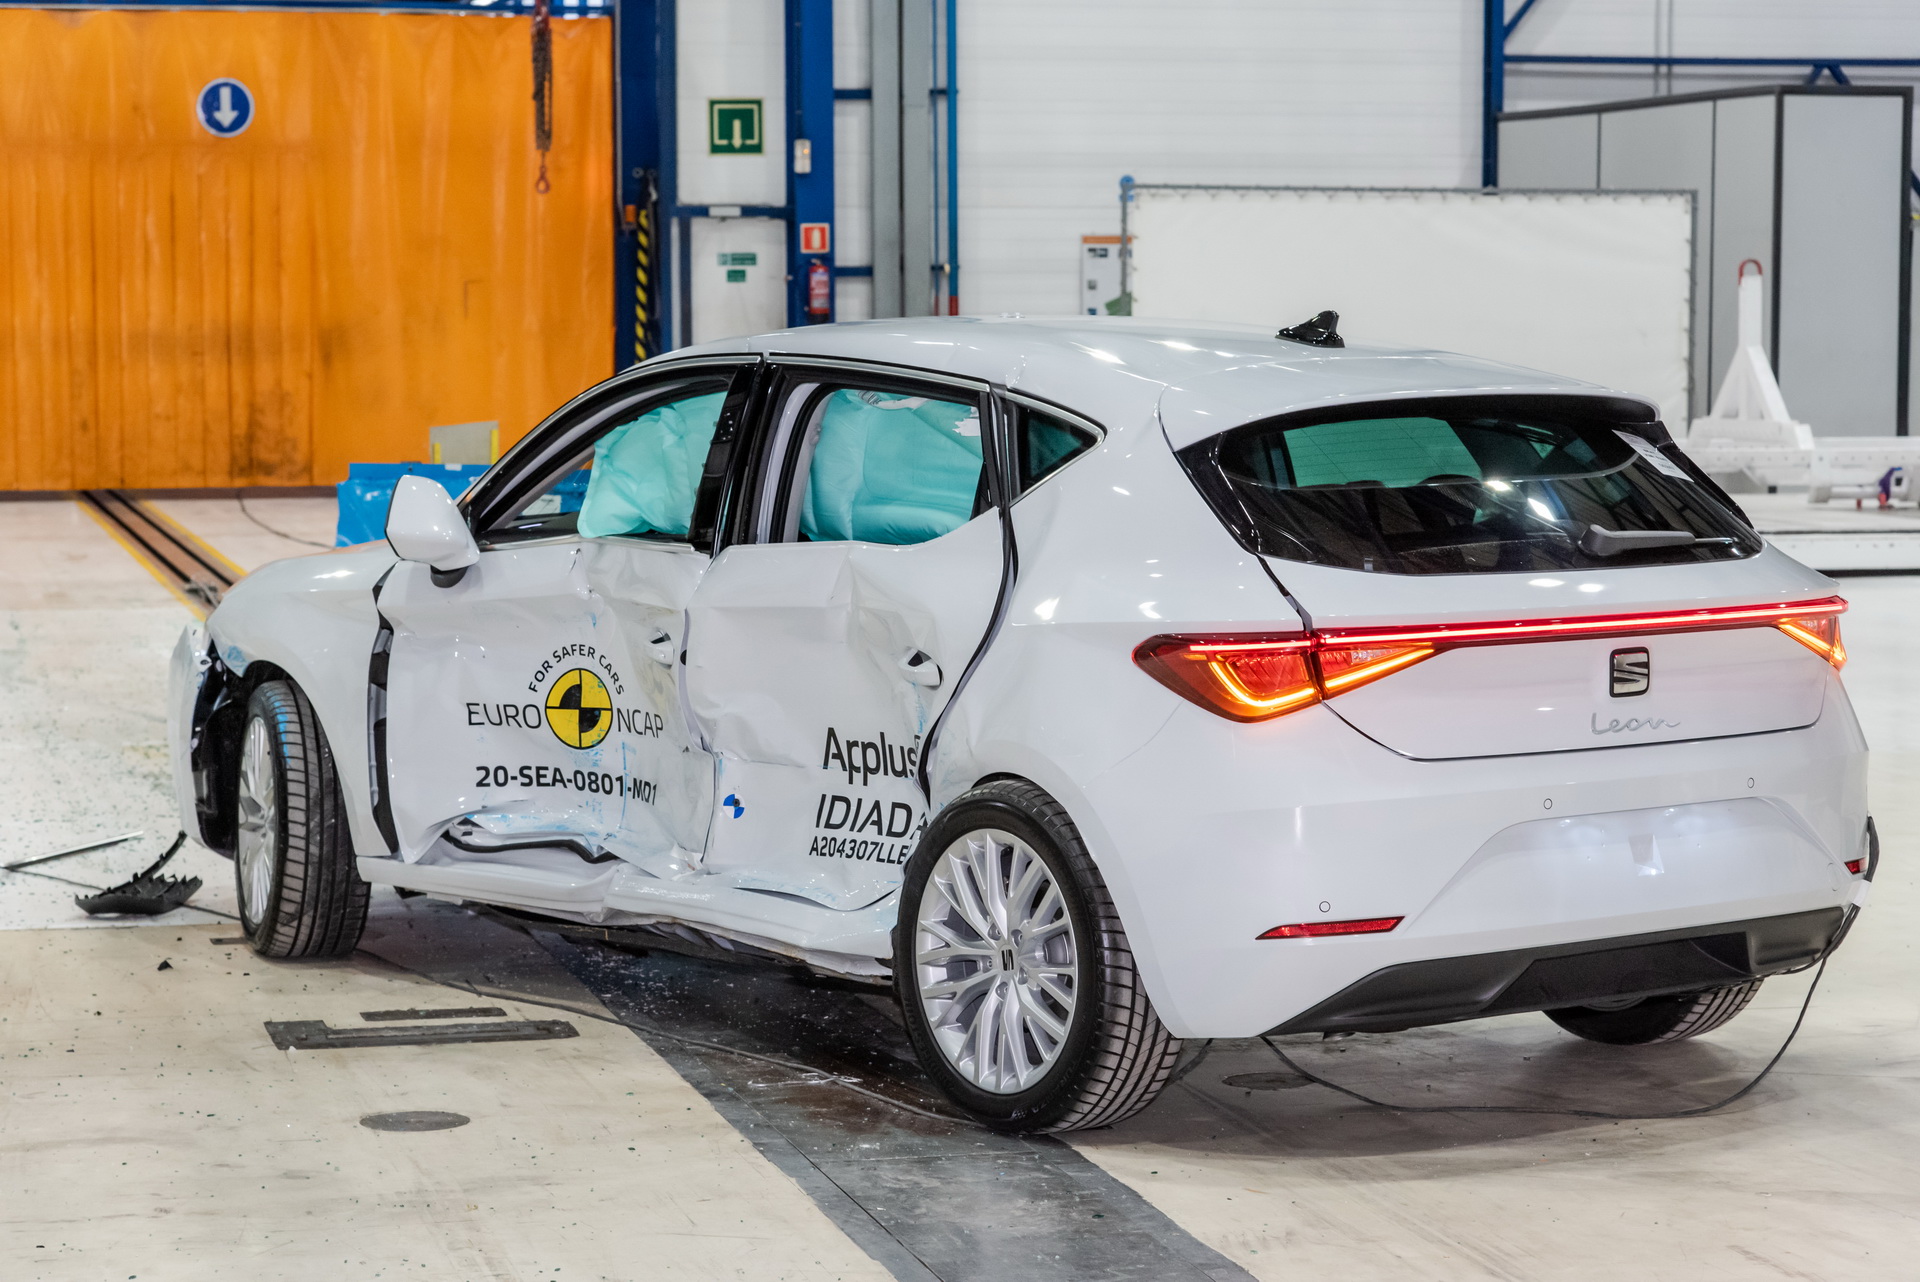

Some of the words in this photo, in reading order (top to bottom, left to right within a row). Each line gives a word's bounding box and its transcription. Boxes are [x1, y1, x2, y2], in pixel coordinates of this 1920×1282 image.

[528, 660, 553, 693] FOR
[552, 643, 596, 663] SAFER
[598, 654, 625, 695] CARS
[466, 702, 542, 729] EURO
[616, 707, 664, 738] NCAP
[1590, 712, 1681, 735] Leon
[475, 765, 657, 806] 20-SEA-0801-M01
